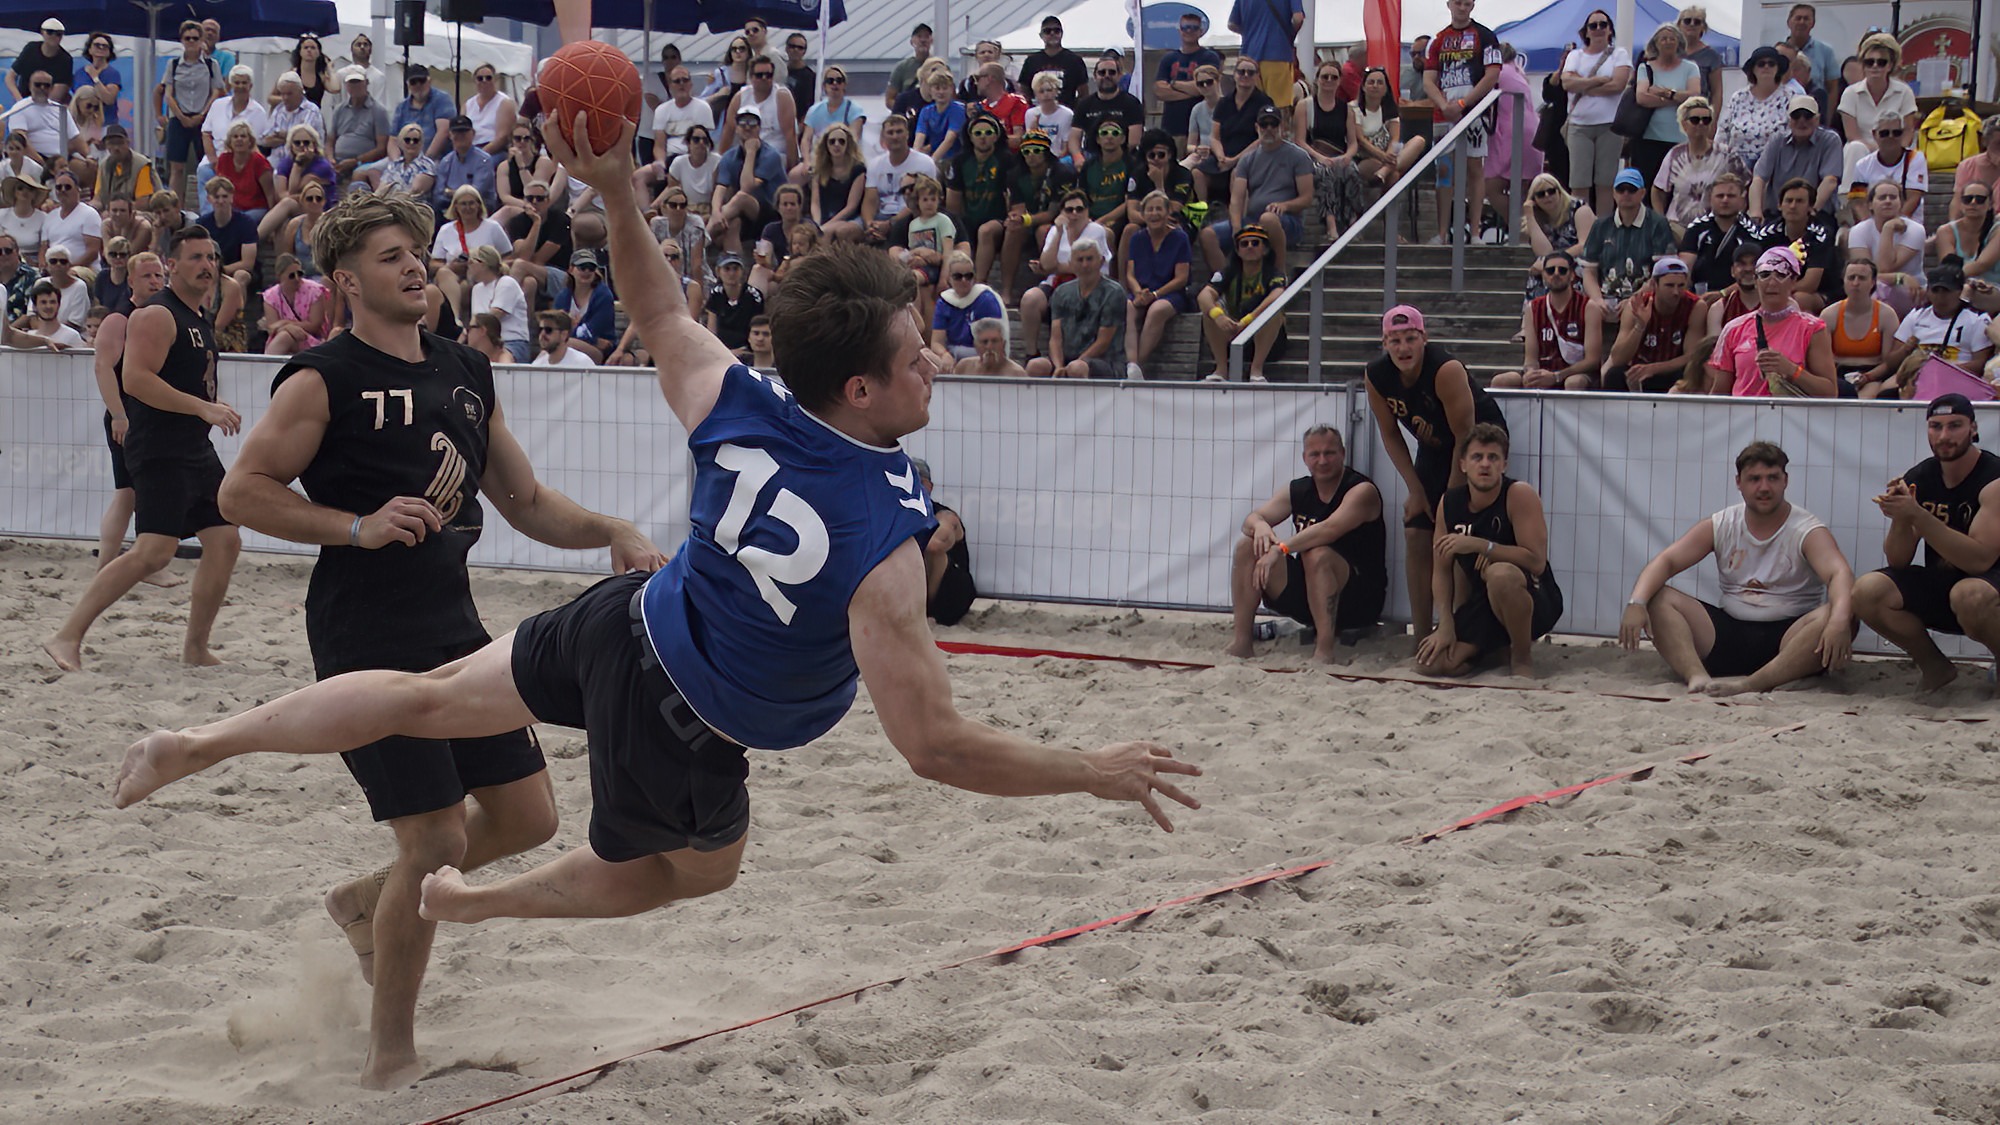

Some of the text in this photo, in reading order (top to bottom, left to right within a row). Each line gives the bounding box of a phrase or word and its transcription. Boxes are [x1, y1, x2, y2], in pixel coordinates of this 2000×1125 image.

[188, 327, 205, 348] 13
[1541, 327, 1554, 342] 10
[1956, 325, 1963, 343] 1
[360, 388, 414, 431] 77
[1386, 397, 1409, 417] 93
[713, 443, 830, 627] 12
